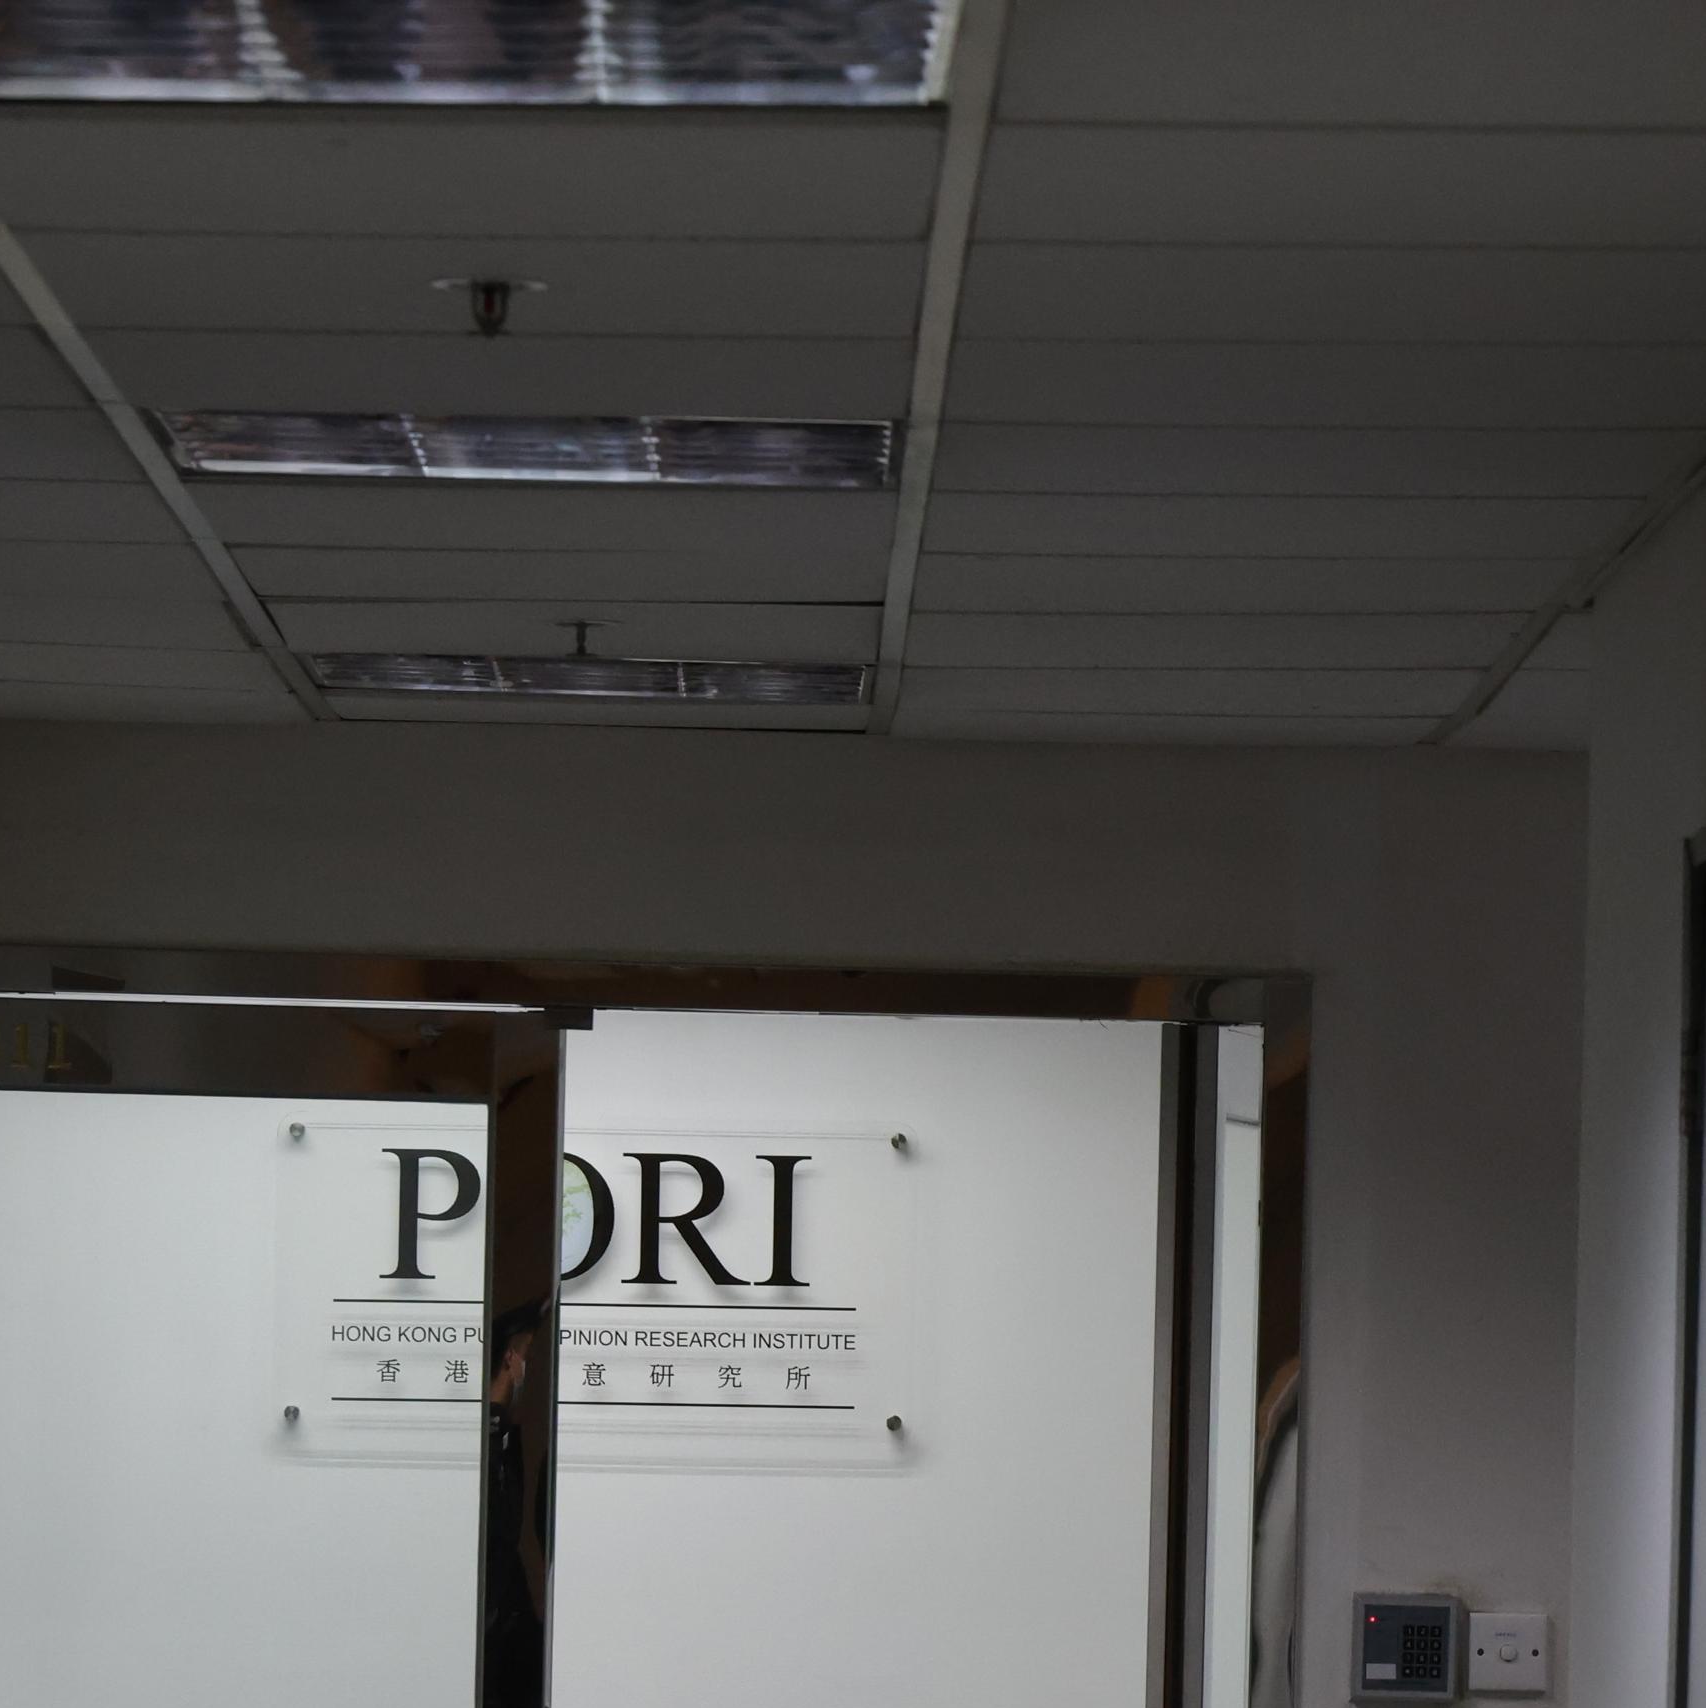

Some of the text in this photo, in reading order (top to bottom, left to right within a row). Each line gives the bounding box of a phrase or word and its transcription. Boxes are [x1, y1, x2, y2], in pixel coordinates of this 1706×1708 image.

[331, 1325, 392, 1344] HONG
[398, 1326, 457, 1345] KONG
[558, 1329, 629, 1348] PINION
[634, 1330, 746, 1349] RESEARCH
[753, 1332, 857, 1352] INSTITUTE
[376, 1358, 812, 1391] 香港意研究所
